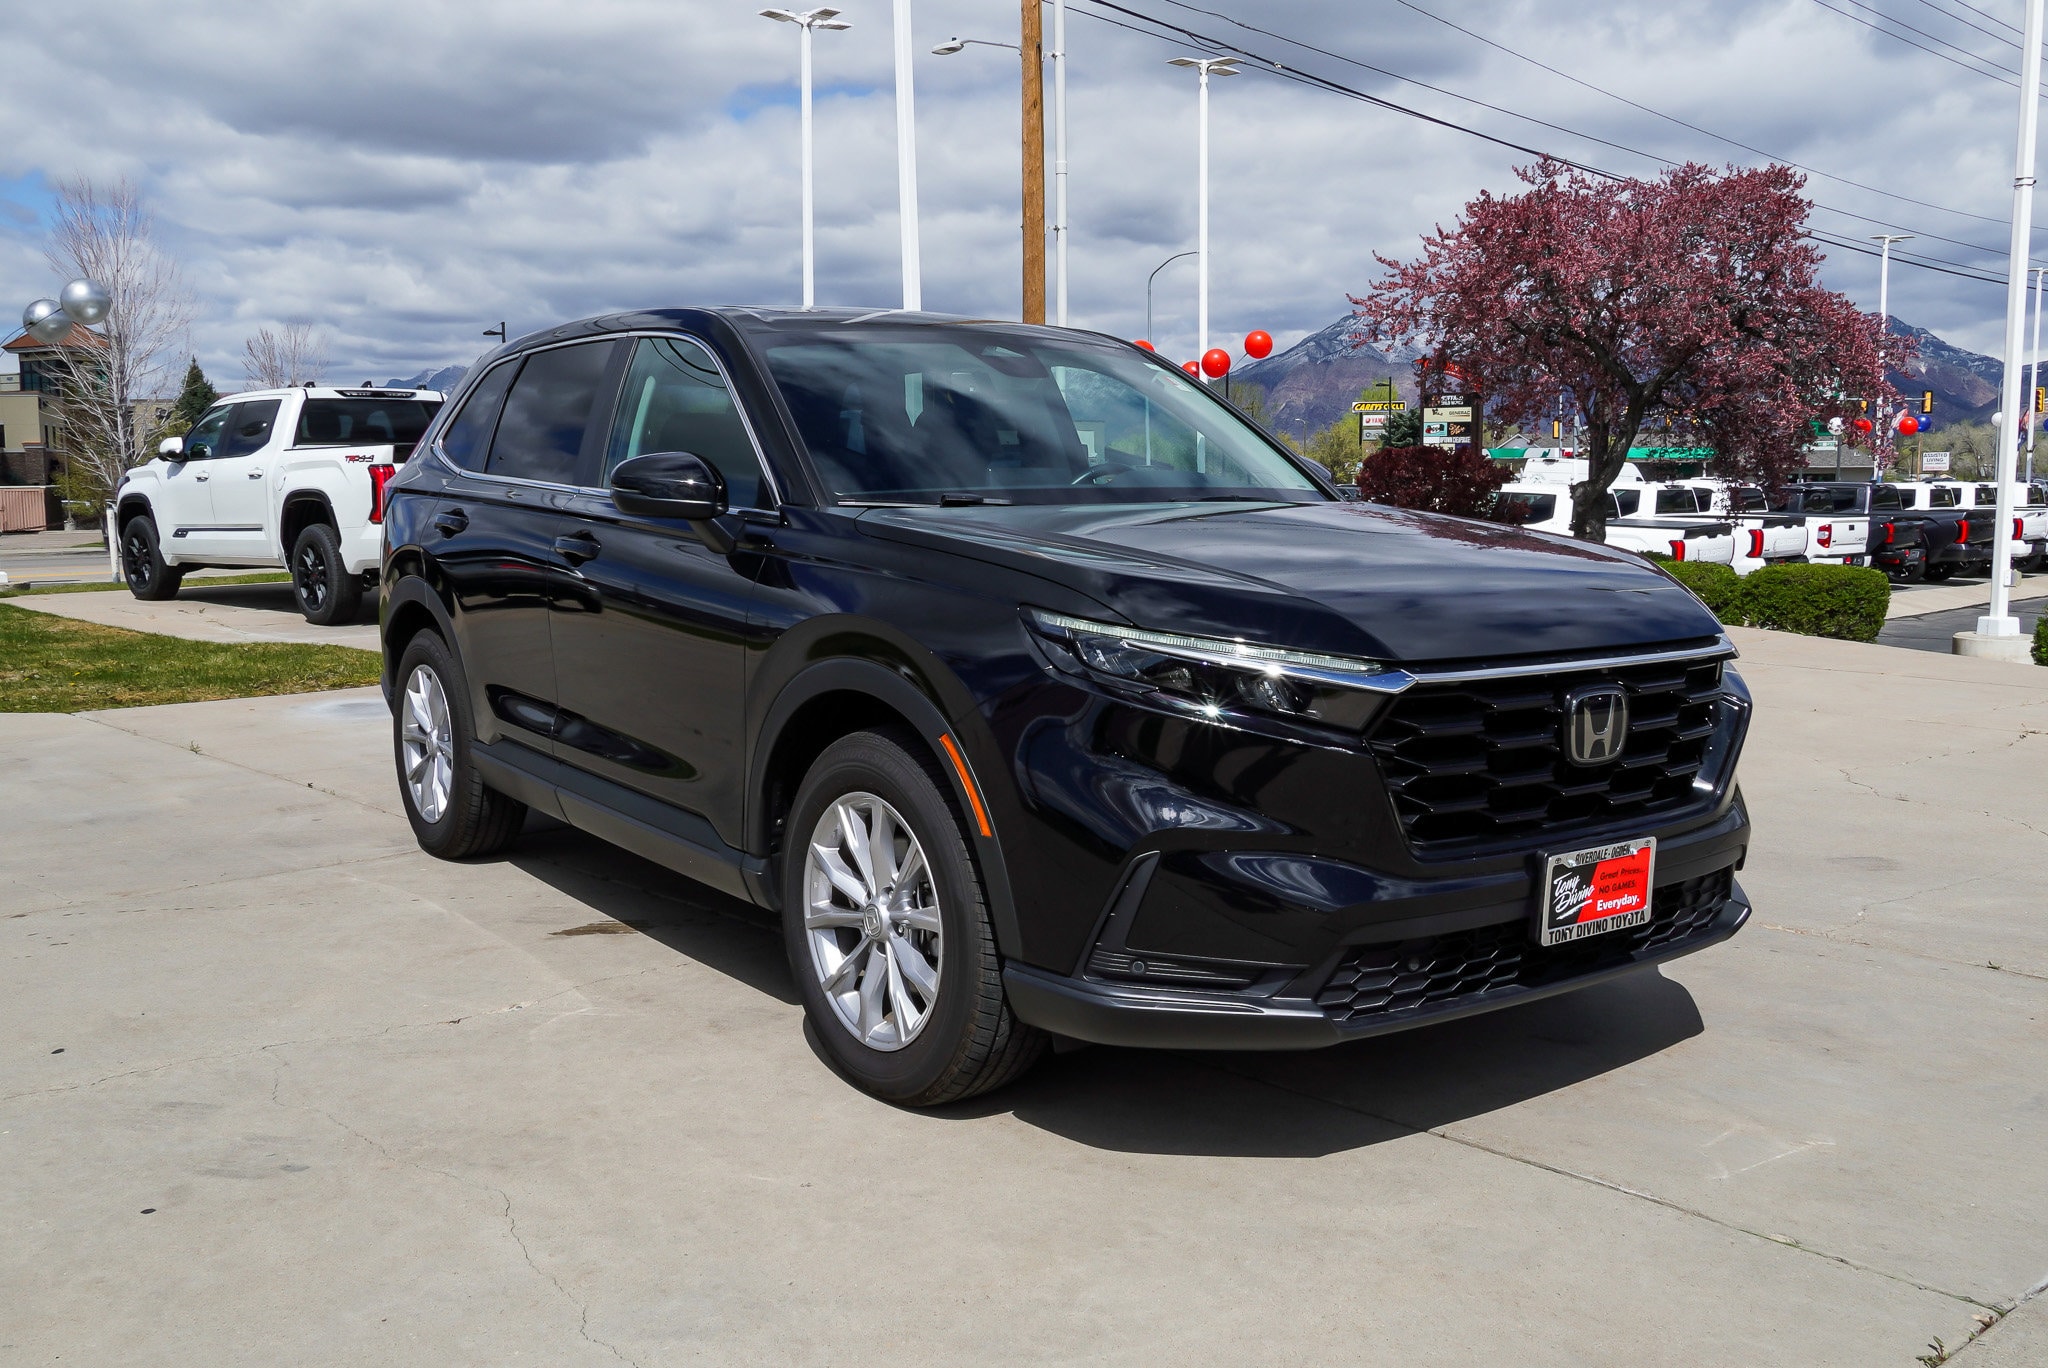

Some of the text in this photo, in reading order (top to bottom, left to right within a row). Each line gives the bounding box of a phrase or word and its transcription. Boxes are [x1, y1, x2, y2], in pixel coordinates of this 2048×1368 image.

[1554, 872, 1580, 896] Tony
[1599, 886, 1610, 894] NO
[1553, 884, 1595, 913] Divino
[1596, 894, 1639, 911] Everyday.
[1549, 911, 1645, 944] TONY DIVINO TOYOTA
